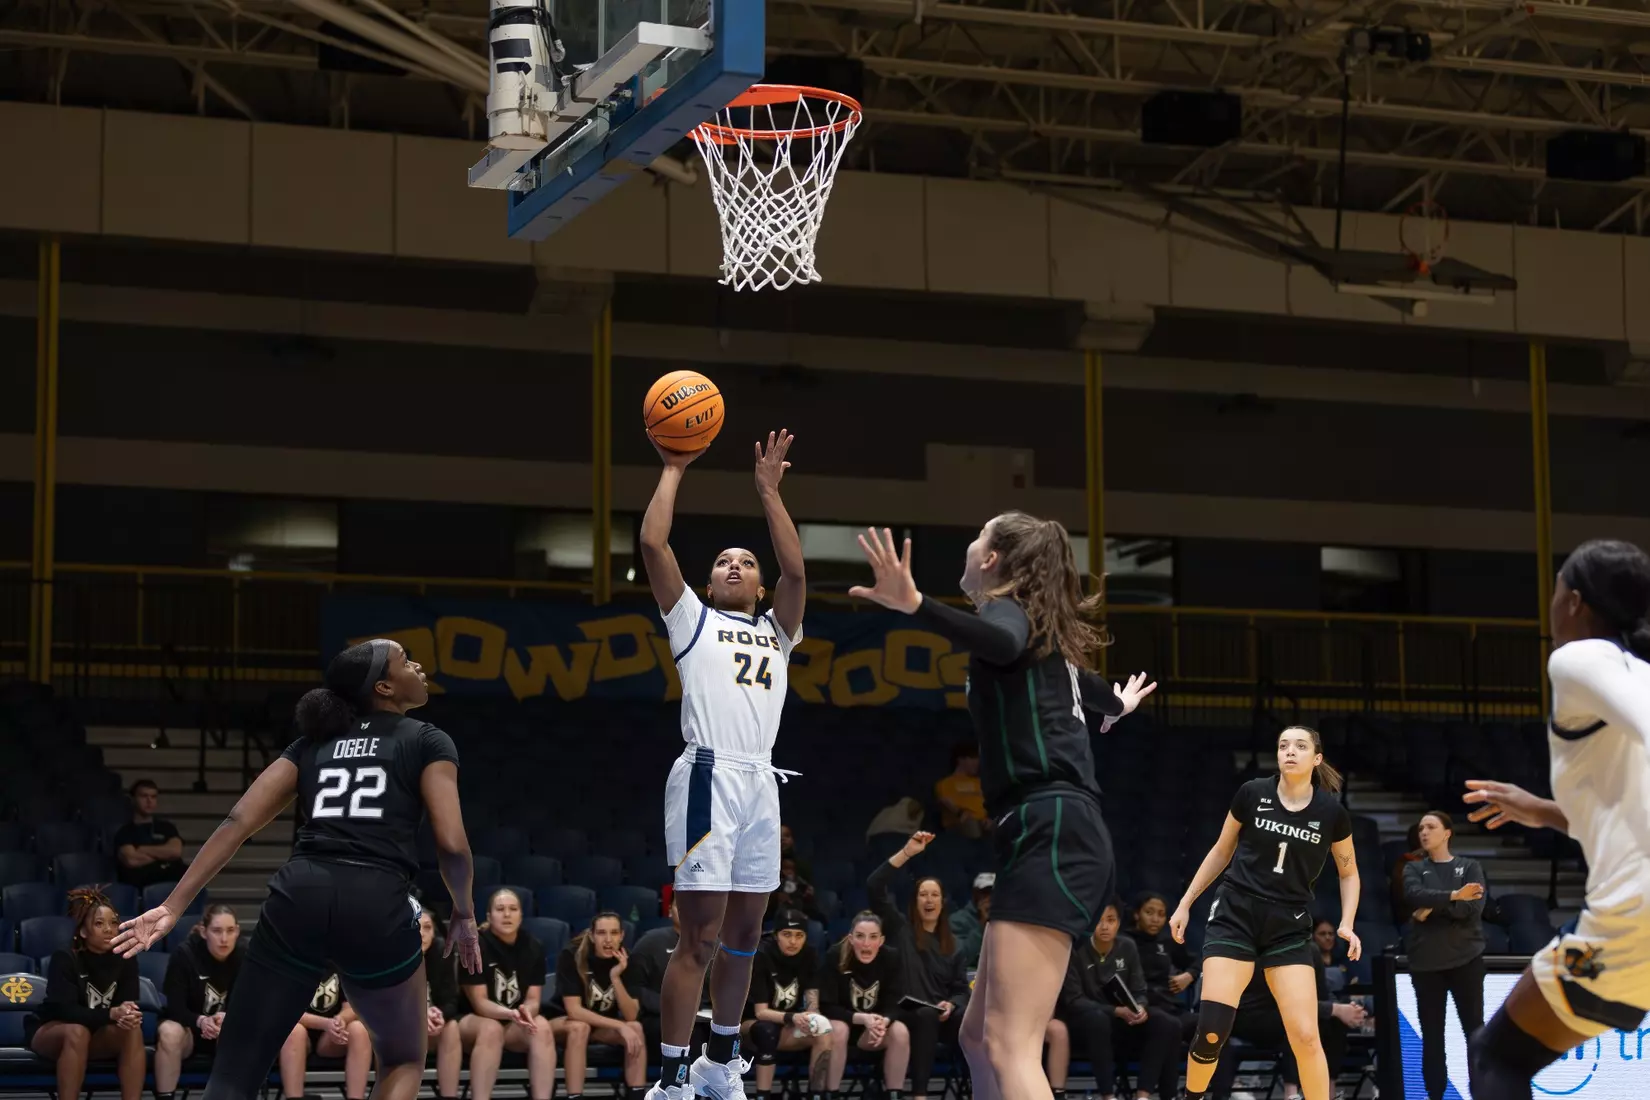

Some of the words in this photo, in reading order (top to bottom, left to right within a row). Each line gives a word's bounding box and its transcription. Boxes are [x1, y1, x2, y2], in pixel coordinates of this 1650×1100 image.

[661, 383, 711, 410] Wilson
[718, 629, 780, 651] ROOS
[734, 652, 772, 690] 24
[332, 737, 380, 759] OGELE
[312, 766, 387, 819] 22
[1254, 816, 1322, 844] VIKINGS
[1272, 841, 1288, 874] 1
[494, 967, 522, 1009] PS
[850, 977, 880, 1012] PS
